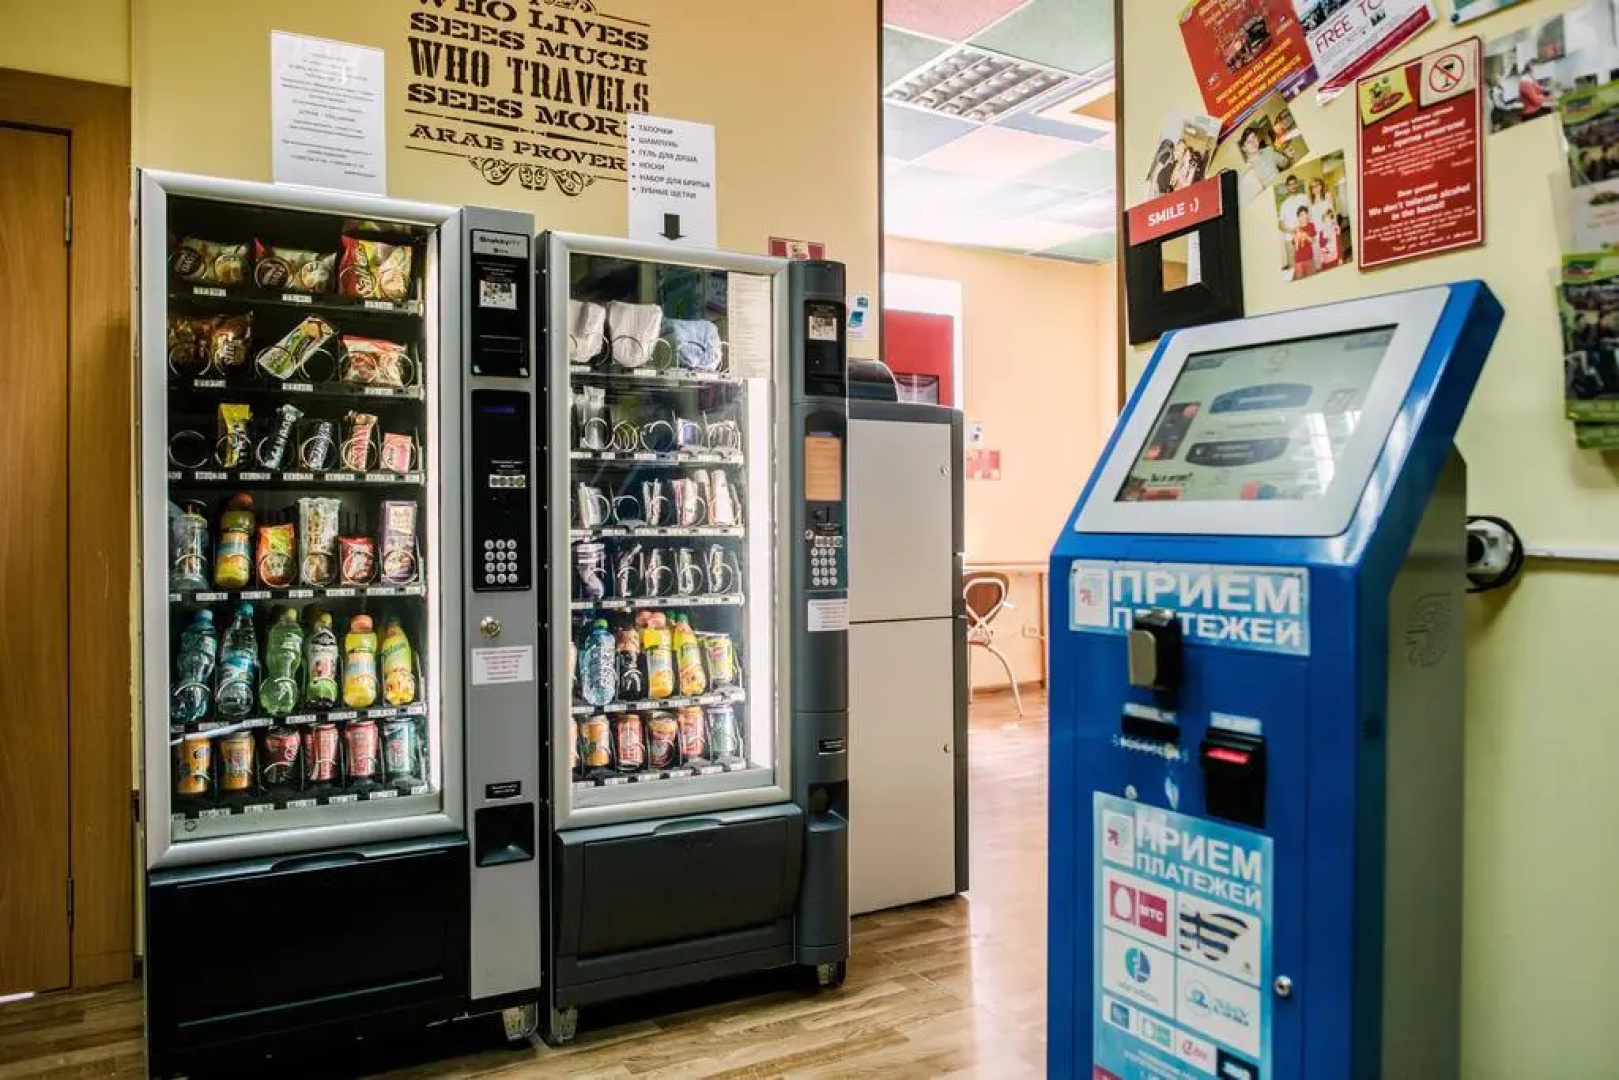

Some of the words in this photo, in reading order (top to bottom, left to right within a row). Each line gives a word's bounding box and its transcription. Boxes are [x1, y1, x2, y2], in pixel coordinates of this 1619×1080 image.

[410, 12, 525, 50] SEES
[536, 37, 648, 77] MUCH
[528, 9, 649, 51] LIVES
[1315, 17, 1353, 54] FREE
[408, 36, 490, 88] WHO
[506, 56, 649, 114] TRAVELS
[408, 83, 523, 119] SEES
[534, 105, 627, 138] MOR
[409, 124, 505, 151] ARAB
[513, 140, 628, 171] PROVER
[1147, 202, 1185, 227] SMILE
[1368, 208, 1382, 216] We
[1383, 202, 1404, 213] don't
[1405, 194, 1438, 207] tolerate
[1439, 182, 1471, 198] alcohol
[1401, 209, 1416, 218] the
[1112, 569, 1301, 615] ПРИЕМ
[1112, 607, 1301, 646] ПТЕЖЕЙ
[1136, 810, 1262, 885] ПРИЕМ
[1136, 853, 1262, 910] ПЛАТЕЖЕЙ
